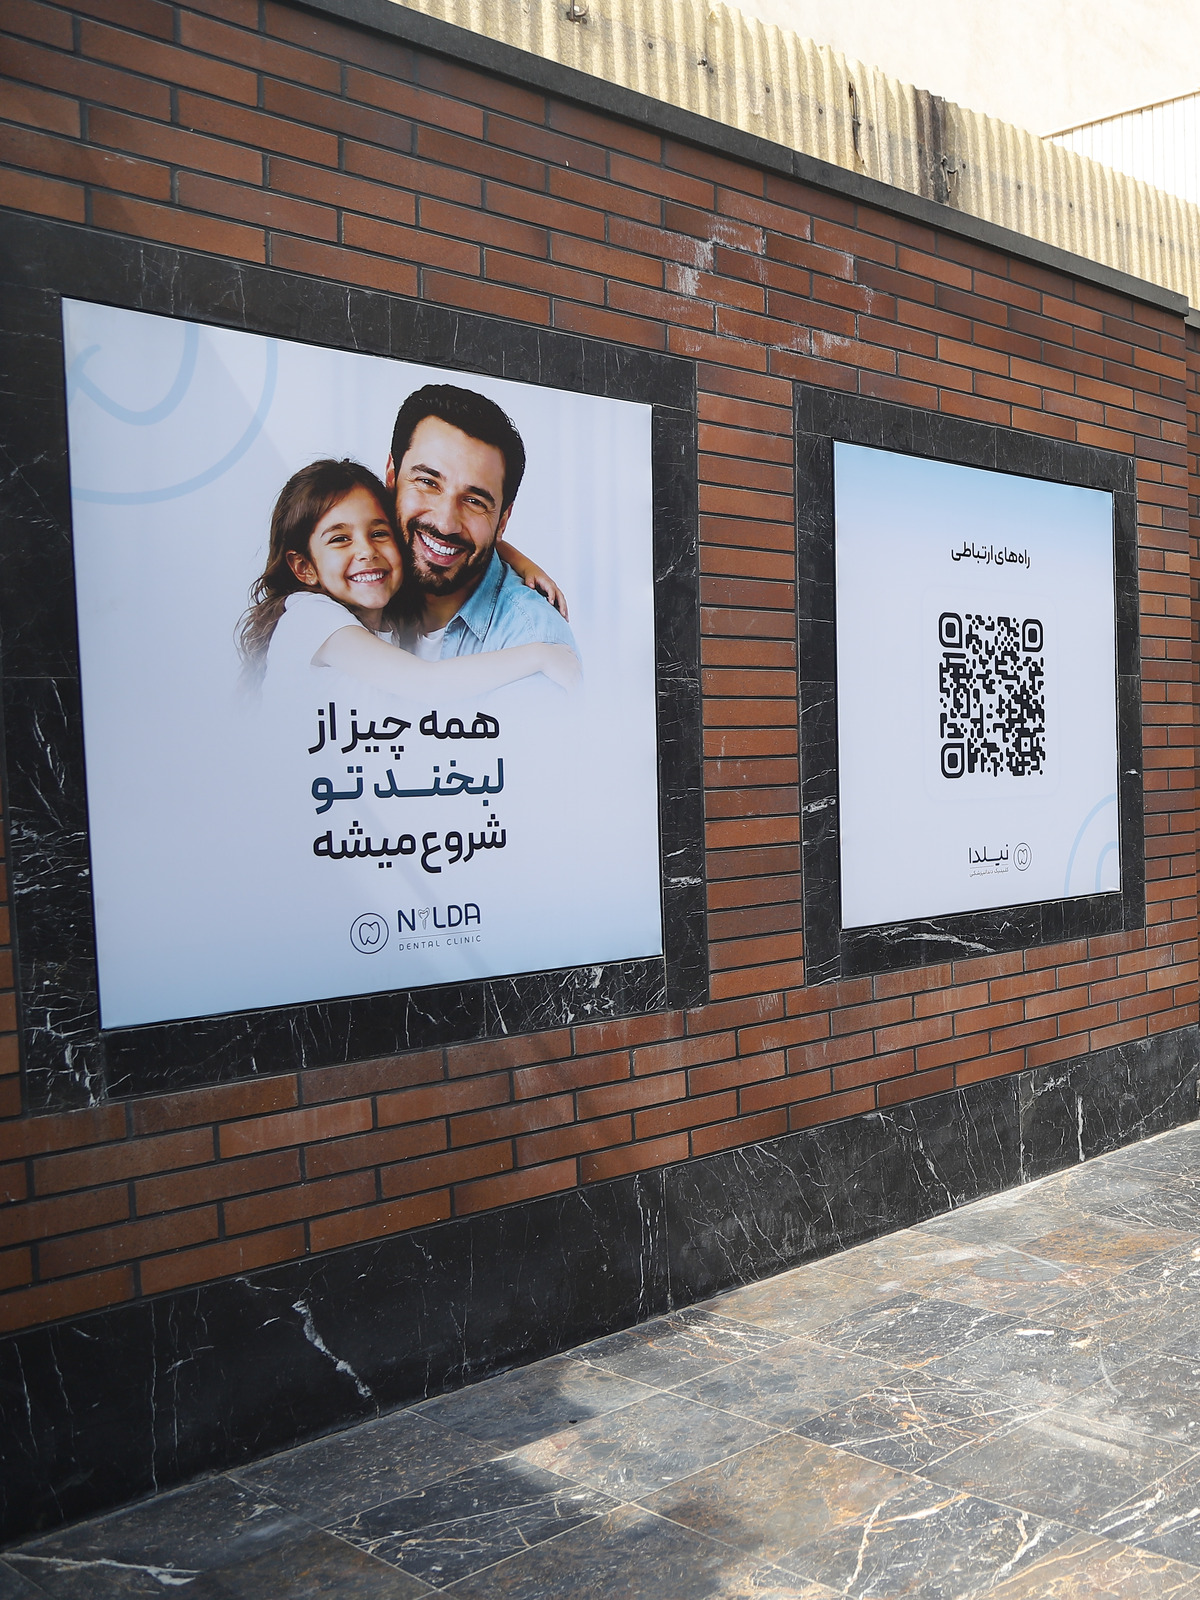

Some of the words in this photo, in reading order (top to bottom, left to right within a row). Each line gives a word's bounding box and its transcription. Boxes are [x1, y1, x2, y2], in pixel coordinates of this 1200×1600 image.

[951, 541, 994, 565] ارتباطی
[307, 701, 337, 754] از
[340, 708, 412, 760] چیز
[418, 709, 501, 740] همه
[311, 765, 364, 815] تو
[373, 757, 505, 807] لبخند
[312, 820, 417, 869] میشه
[419, 813, 508, 874] شروع
[968, 843, 1009, 866] نیلدا
[398, 940, 440, 952] DENTAL
[446, 934, 482, 947] CLINIC
